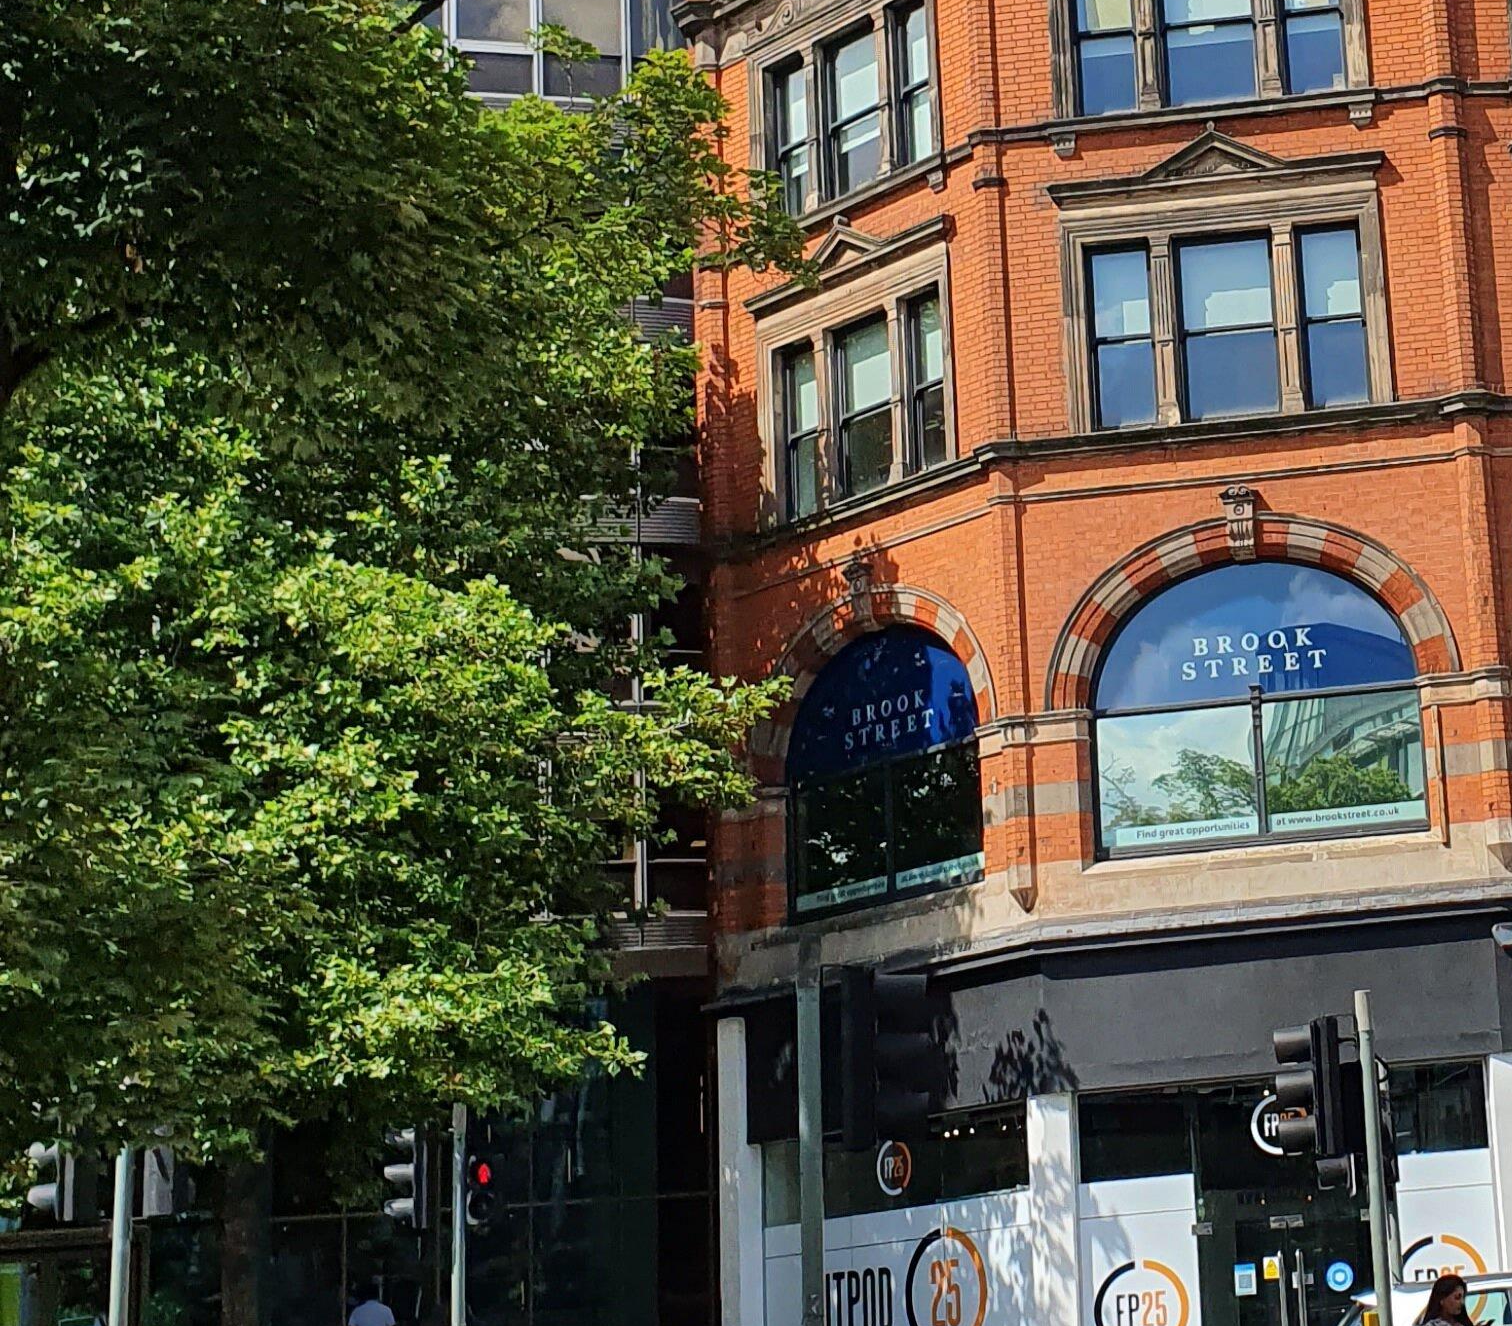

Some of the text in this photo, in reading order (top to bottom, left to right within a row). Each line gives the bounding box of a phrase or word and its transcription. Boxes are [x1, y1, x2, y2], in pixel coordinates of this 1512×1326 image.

[1192, 627, 1313, 657] BROOK
[1181, 649, 1327, 681] STREET
[852, 689, 925, 726] BROOK
[845, 708, 934, 750] STREET
[1136, 821, 1250, 840] Find great opportunities
[1276, 805, 1400, 826] at www.brookstreet.co.uk
